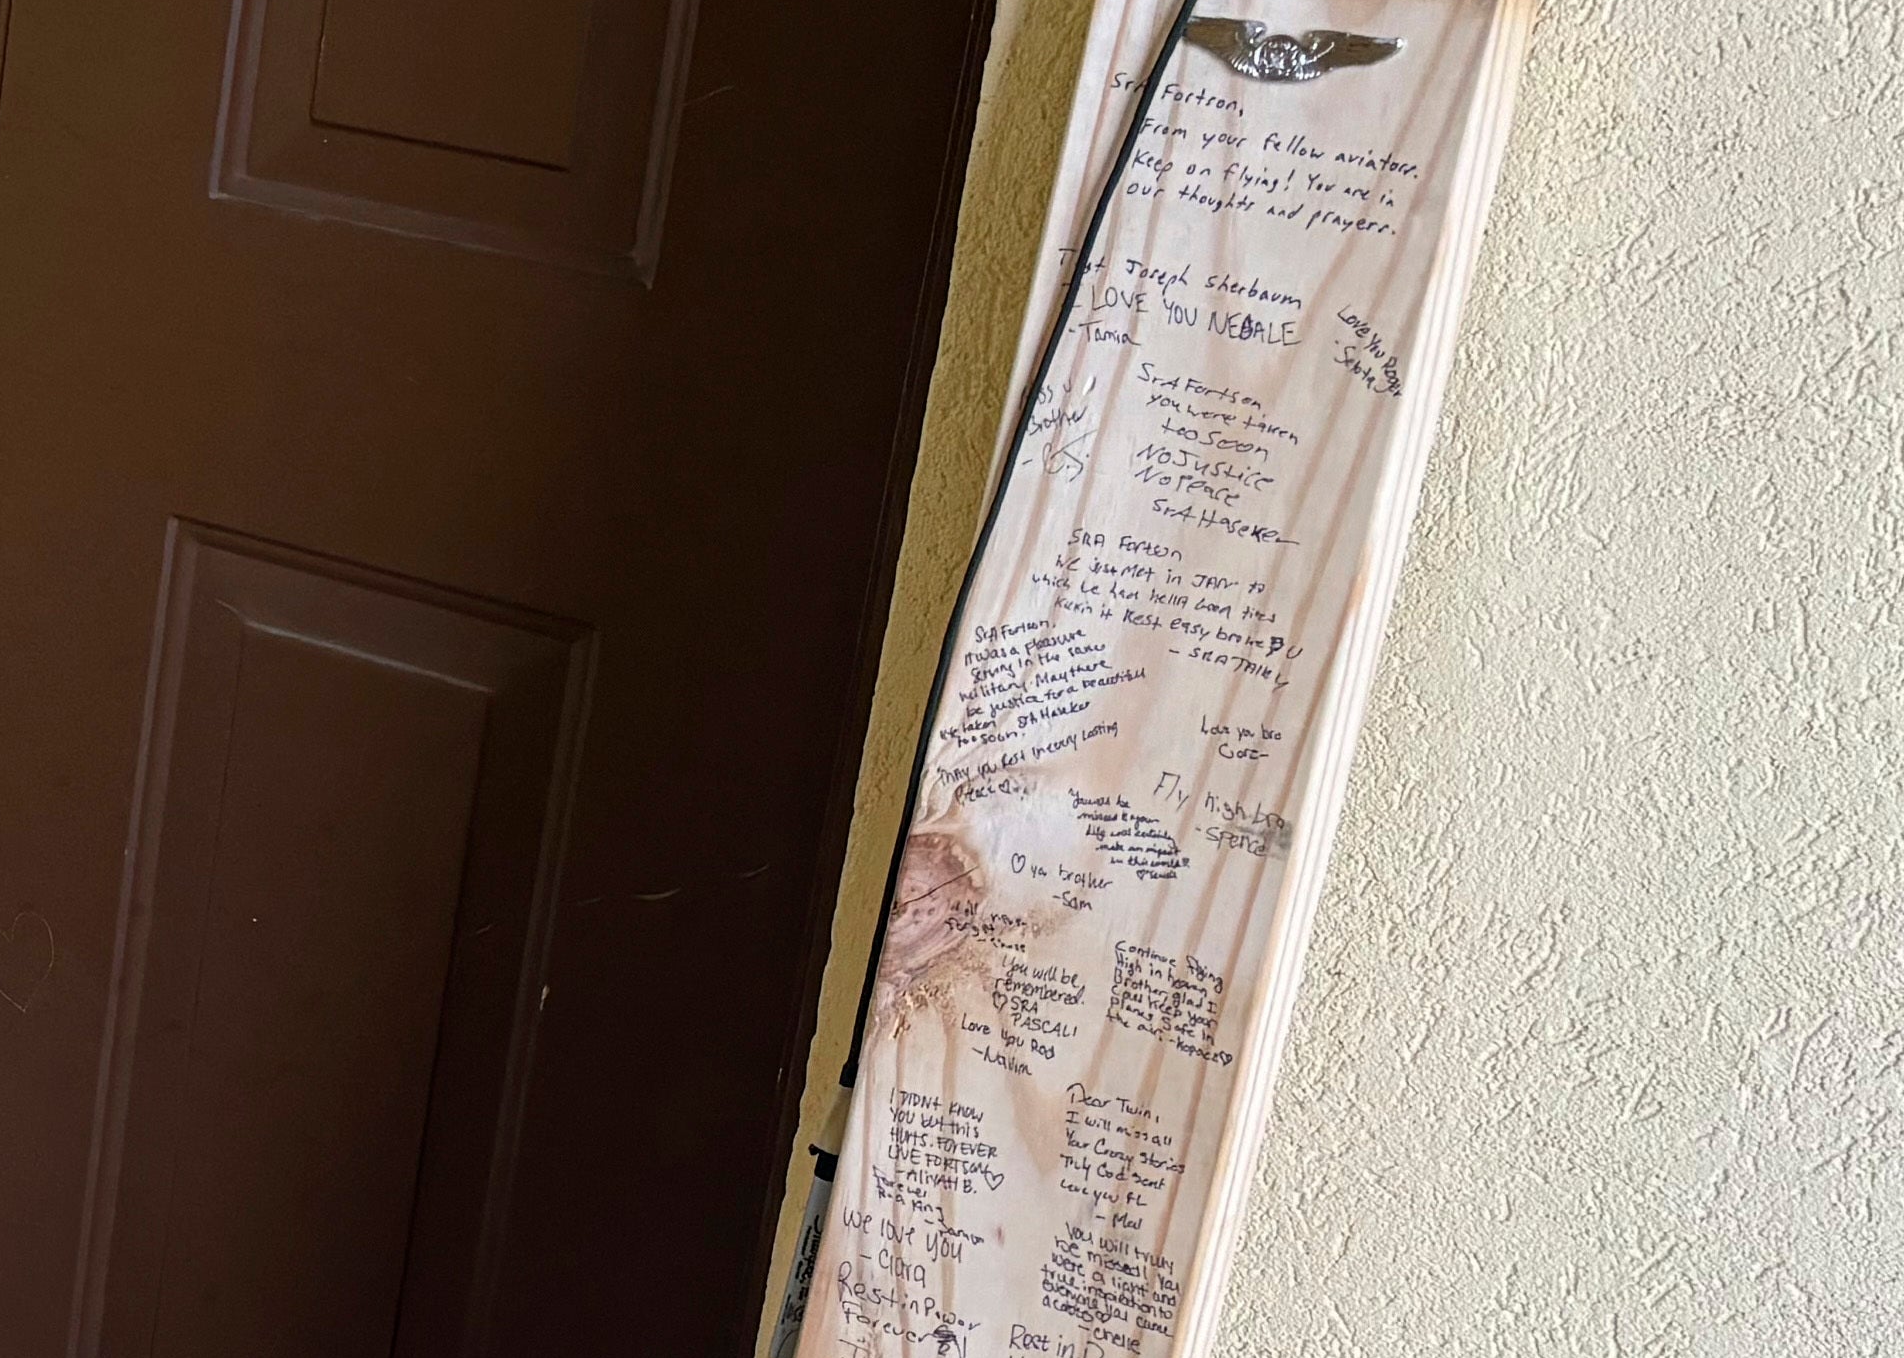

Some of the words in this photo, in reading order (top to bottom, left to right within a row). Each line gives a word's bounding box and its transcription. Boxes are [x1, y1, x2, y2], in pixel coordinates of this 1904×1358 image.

[1140, 118, 1187, 139] From
[1202, 129, 1247, 149] your
[1132, 148, 1174, 181] Keep
[1186, 164, 1211, 177] on
[1308, 174, 1335, 193] You
[1343, 185, 1370, 201] are
[1379, 190, 1394, 207] in
[1127, 183, 1165, 198] our
[1178, 184, 1256, 213] thoughts
[1267, 205, 1297, 220] and
[1126, 258, 1191, 295] Joseph
[1091, 285, 1149, 312] LOVE
[1163, 297, 1198, 327] YOU
[1146, 393, 1181, 414] you
[1161, 417, 1198, 441] too
[1166, 569, 1182, 585] in
[1154, 771, 1190, 812] Fly
[1032, 966, 1057, 982] will
[1150, 962, 1162, 978] in
[1011, 996, 1038, 1014] SRA
[961, 1012, 991, 1035] Love
[890, 1107, 915, 1124] YOU
[1066, 1111, 1079, 1124] I
[880, 1217, 916, 1245] love
[1099, 1237, 1129, 1255] will
[837, 1260, 899, 1309] Rest
[1009, 1324, 1051, 1352] Rest
